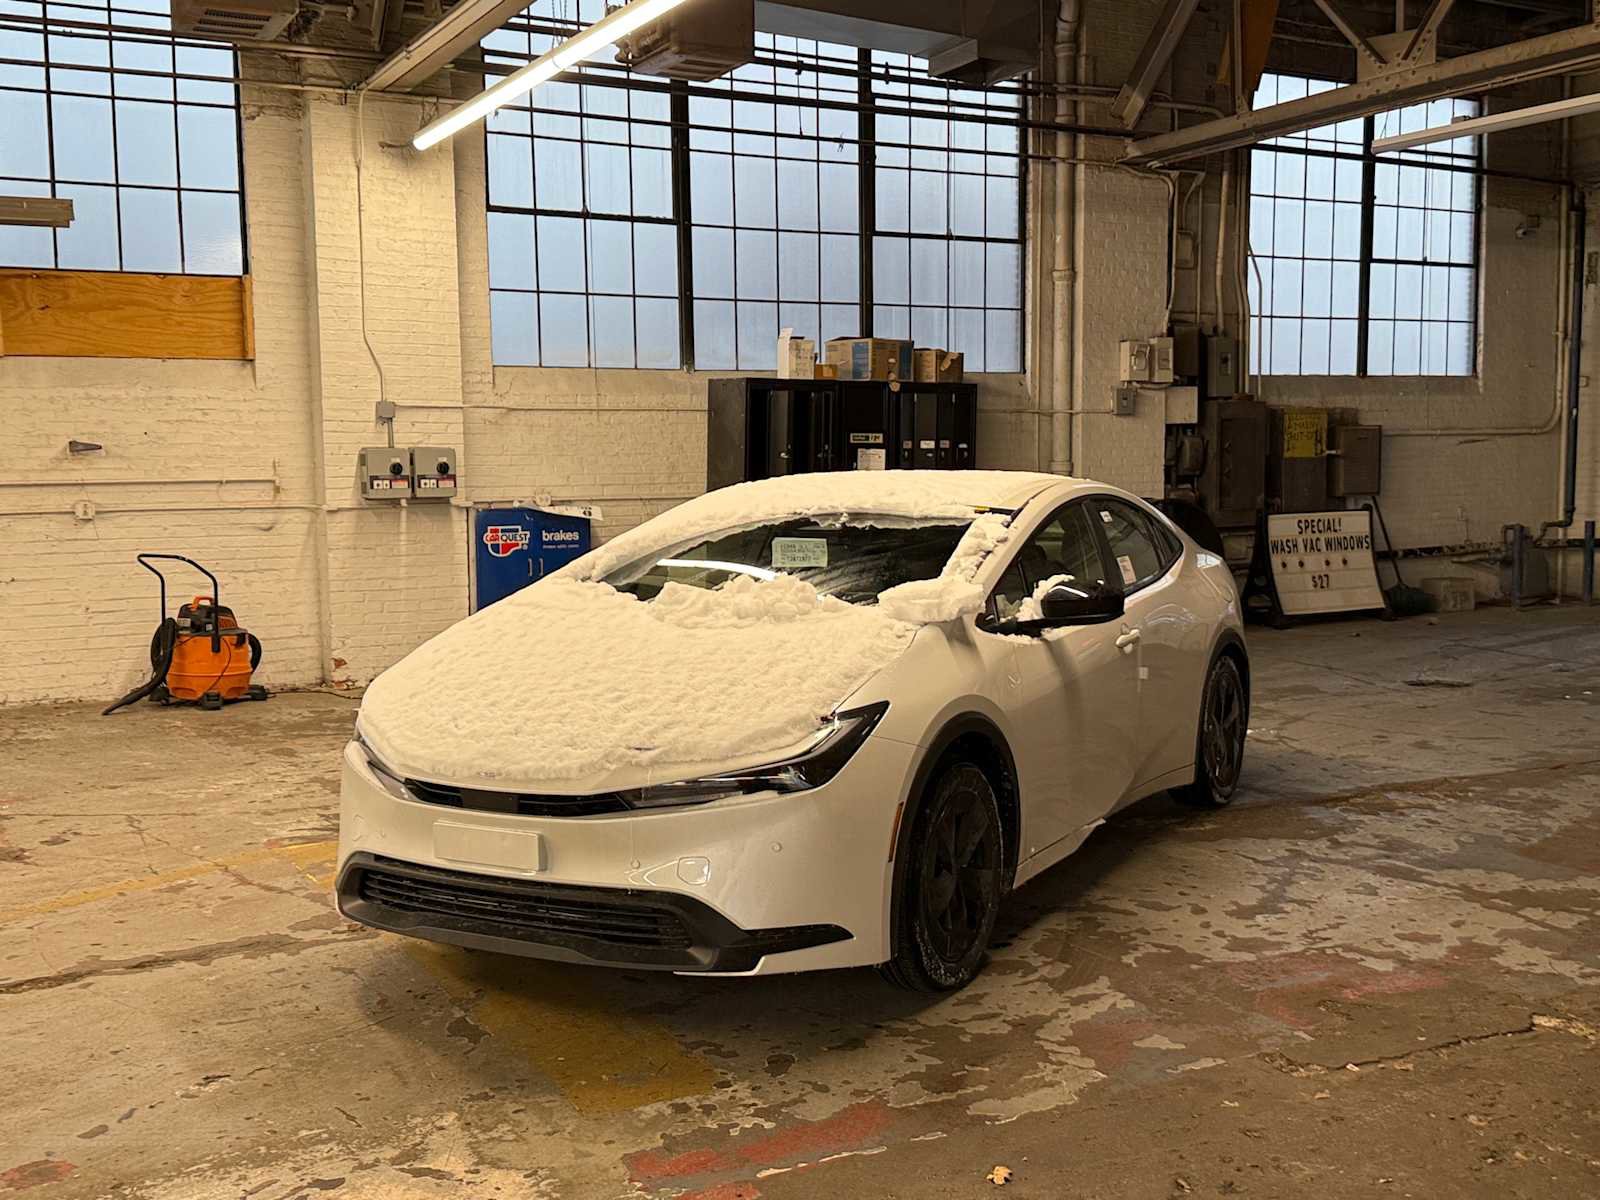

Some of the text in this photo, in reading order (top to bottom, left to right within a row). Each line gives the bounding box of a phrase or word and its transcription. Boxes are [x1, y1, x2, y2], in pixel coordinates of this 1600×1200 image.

[1297, 518, 1342, 534] SPECIAL!
[542, 530, 579, 541] brakes
[1271, 535, 1370, 554] WASH VAC WINDOWS
